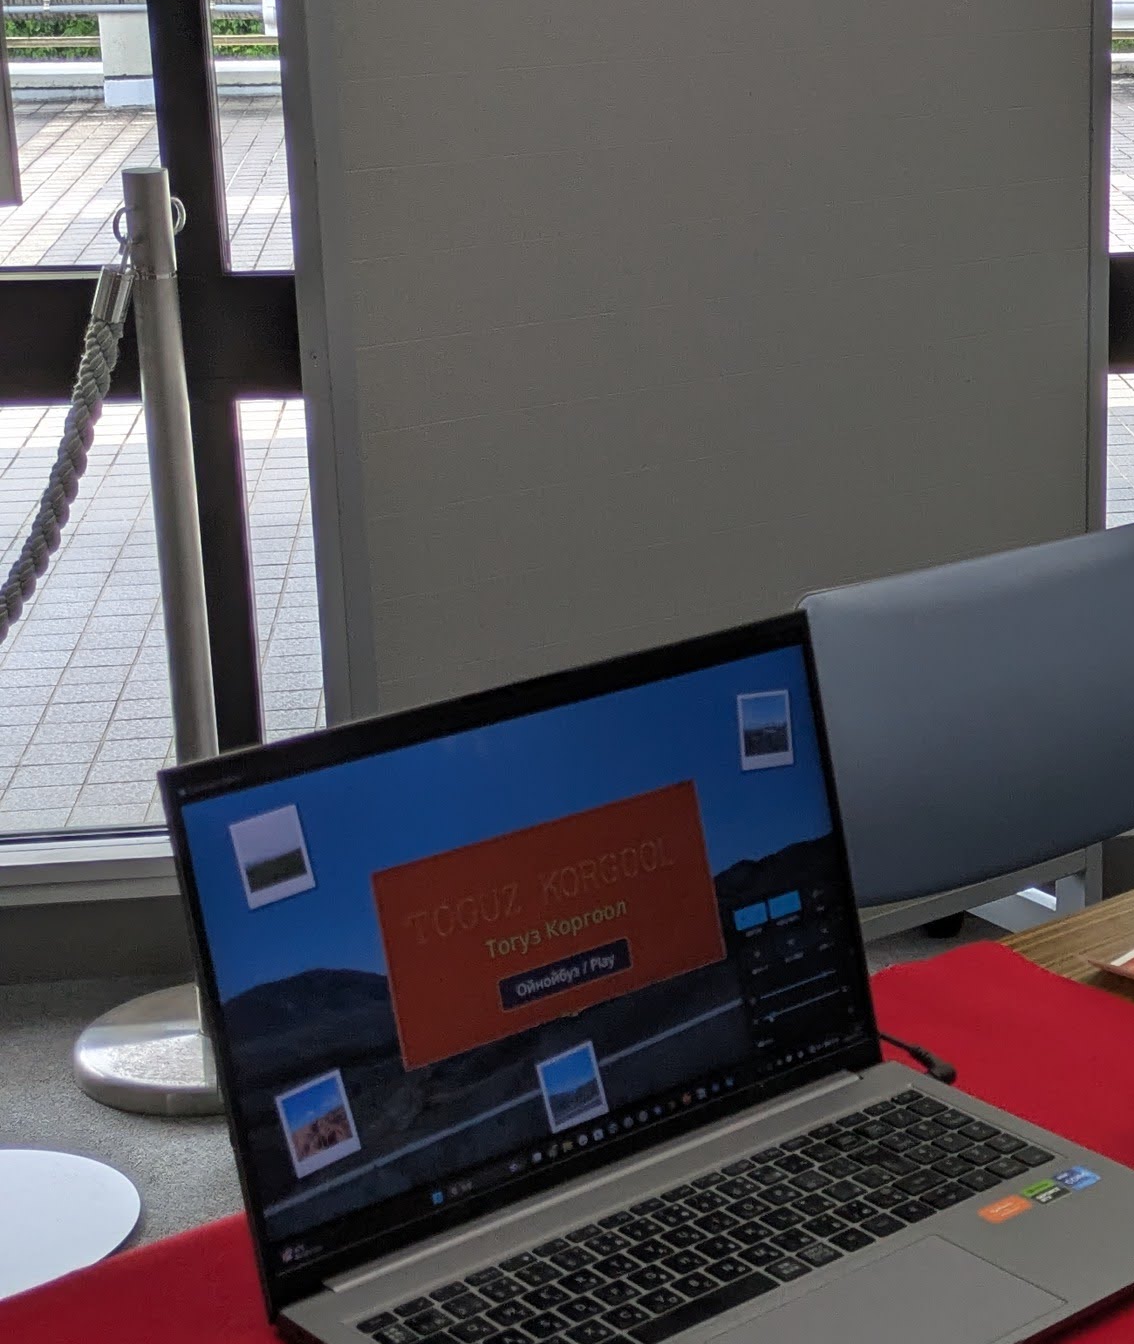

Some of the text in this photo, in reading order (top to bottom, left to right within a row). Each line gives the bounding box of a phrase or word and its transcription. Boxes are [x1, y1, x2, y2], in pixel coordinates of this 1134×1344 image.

[485, 899, 628, 959] Тогуз Коргоол
[590, 953, 616, 974] Play
